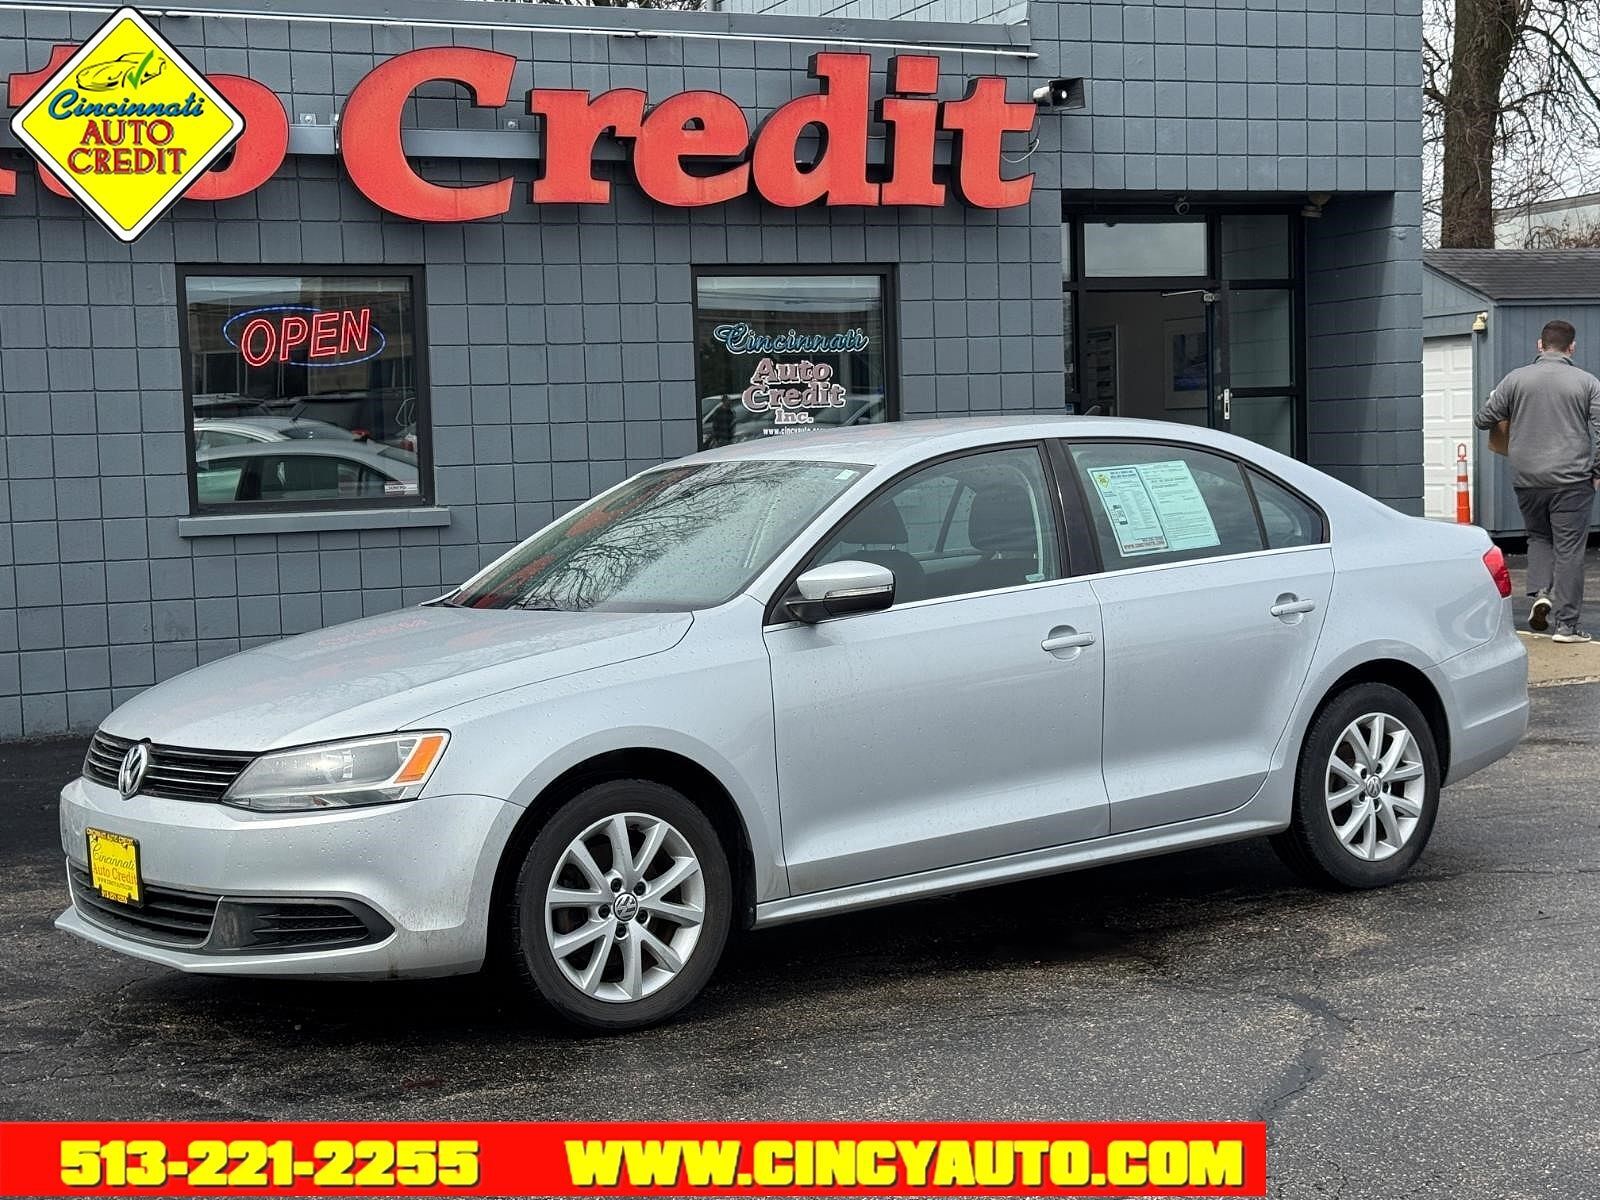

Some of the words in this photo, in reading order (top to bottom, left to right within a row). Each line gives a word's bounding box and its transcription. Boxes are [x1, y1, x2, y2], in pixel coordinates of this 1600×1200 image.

[340, 46, 1036, 222] Credit
[241, 308, 370, 367] OPEN
[714, 322, 869, 354] Cincinnati
[750, 357, 833, 386] Auto
[742, 380, 847, 412] Credit
[774, 408, 814, 425] Inc.
[93, 842, 136, 870] Cincinnati
[93, 863, 111, 878] Auto
[112, 868, 137, 885] Credit
